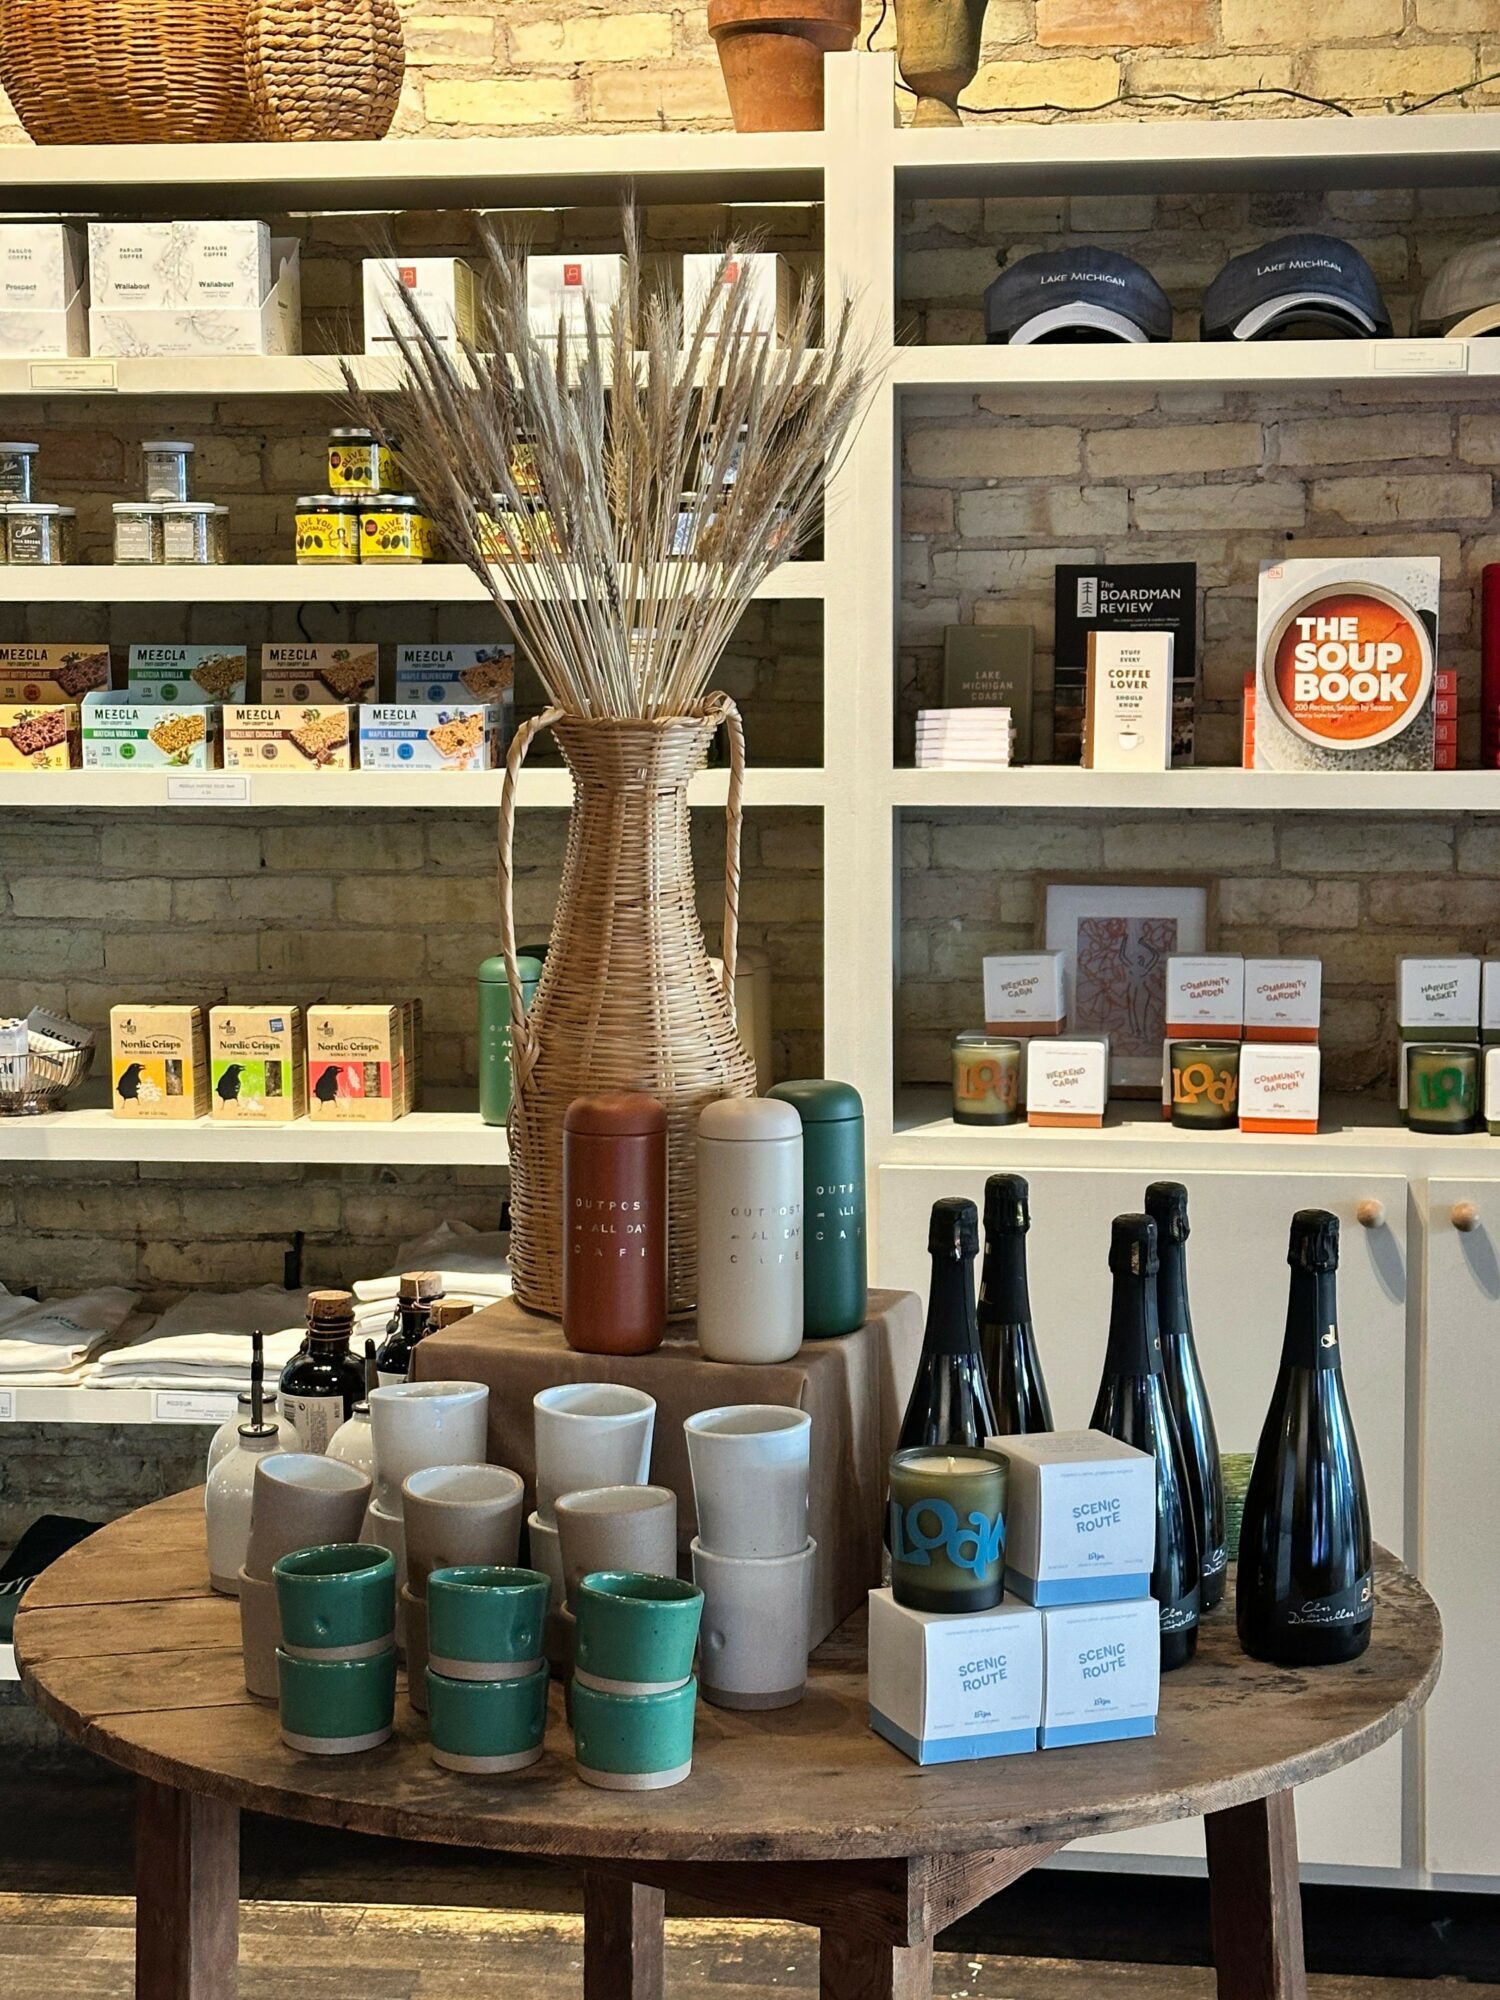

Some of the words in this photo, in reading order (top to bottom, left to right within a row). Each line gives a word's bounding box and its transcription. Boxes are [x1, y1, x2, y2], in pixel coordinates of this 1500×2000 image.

[1256, 262, 1285, 276] LAKE
[1289, 259, 1343, 274] MICHIGAN
[1040, 273, 1068, 285] LAKE
[1070, 272, 1126, 288] MICHIGAN
[6, 284, 37, 292] Prospect
[315, 517, 333, 532] YOU
[1100, 580, 1114, 588] The
[1100, 588, 1181, 601] BOARDMAN
[1100, 602, 1154, 614] REVIEW
[1295, 617, 1359, 641] THE
[137, 650, 187, 661] MEZCLA
[269, 649, 318, 660] MEZCLA
[404, 650, 454, 662] MEZCLA
[1294, 642, 1403, 672] SOUP
[975, 671, 1001, 680] LAKE
[1108, 669, 1151, 679] COFFEE
[962, 681, 1014, 690] MICHIGAN
[1110, 680, 1149, 689] LOVER
[1294, 672, 1408, 702] BOOK
[971, 692, 1004, 701] COAST
[1294, 703, 1308, 711] 200
[1336, 703, 1360, 712] Season
[1360, 704, 1370, 713] by
[1370, 704, 1394, 712] Season
[94, 709, 139, 720] MEZCLA
[236, 709, 281, 720] MEZCLA
[372, 709, 417, 720] MEZCLA
[368, 730, 388, 738] MAPLE
[388, 730, 419, 738] BLUEBERRY
[1000, 977, 1039, 991] WEEKEND
[1180, 977, 1230, 992] COMMUNITY
[1256, 979, 1307, 994] COMMUNITY
[1420, 980, 1459, 994] HARVEST
[1007, 987, 1033, 998] CABIN
[1189, 987, 1224, 999] GARDEN
[1265, 990, 1301, 1002] GARDEN
[1425, 990, 1458, 1002] BASKET
[120, 1040, 151, 1049] Nordic
[152, 1040, 182, 1050] Crisps
[219, 1041, 250, 1050] Nordic
[251, 1041, 281, 1051] Crisps
[317, 1042, 348, 1051] Nordic
[350, 1042, 380, 1052] Crisps
[1046, 1067, 1086, 1080] WEEKEND
[1253, 1070, 1306, 1085] COMMUNITY
[1052, 1078, 1079, 1087] CABIN
[1263, 1081, 1299, 1093] GARDEN
[1072, 1498, 1121, 1519] SCENIC
[1076, 1511, 1121, 1534] ROUTE
[1301, 1601, 1331, 1613] Clos
[1078, 1642, 1126, 1665] SCENIC
[958, 1654, 1008, 1678] SCENIC
[1082, 1656, 1126, 1680] ROUTE
[962, 1670, 1008, 1692] ROUTE
